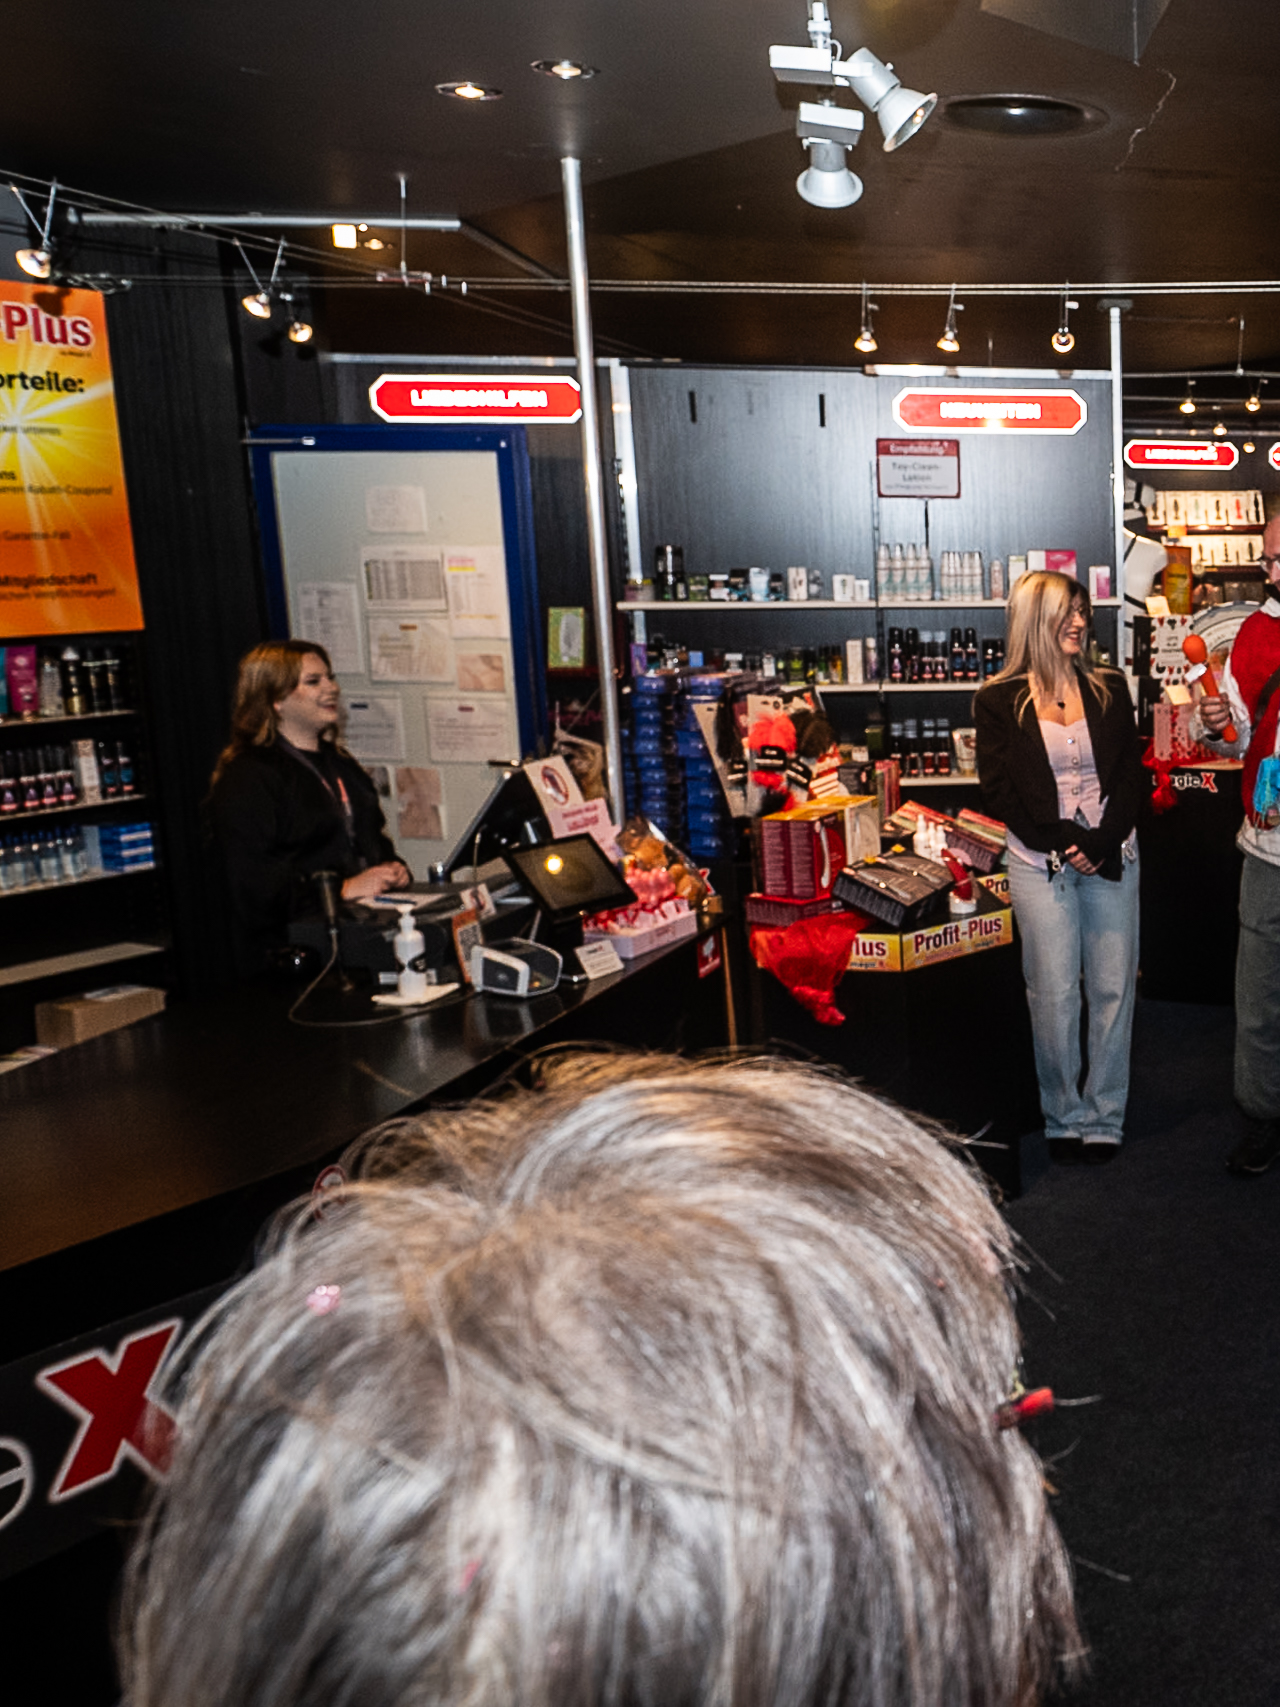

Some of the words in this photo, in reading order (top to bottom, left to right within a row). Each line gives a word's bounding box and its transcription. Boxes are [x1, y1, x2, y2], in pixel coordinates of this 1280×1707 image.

[0, 304, 92, 347] Plus
[854, 937, 887, 957] lus
[913, 918, 1003, 954] Profit-Plus
